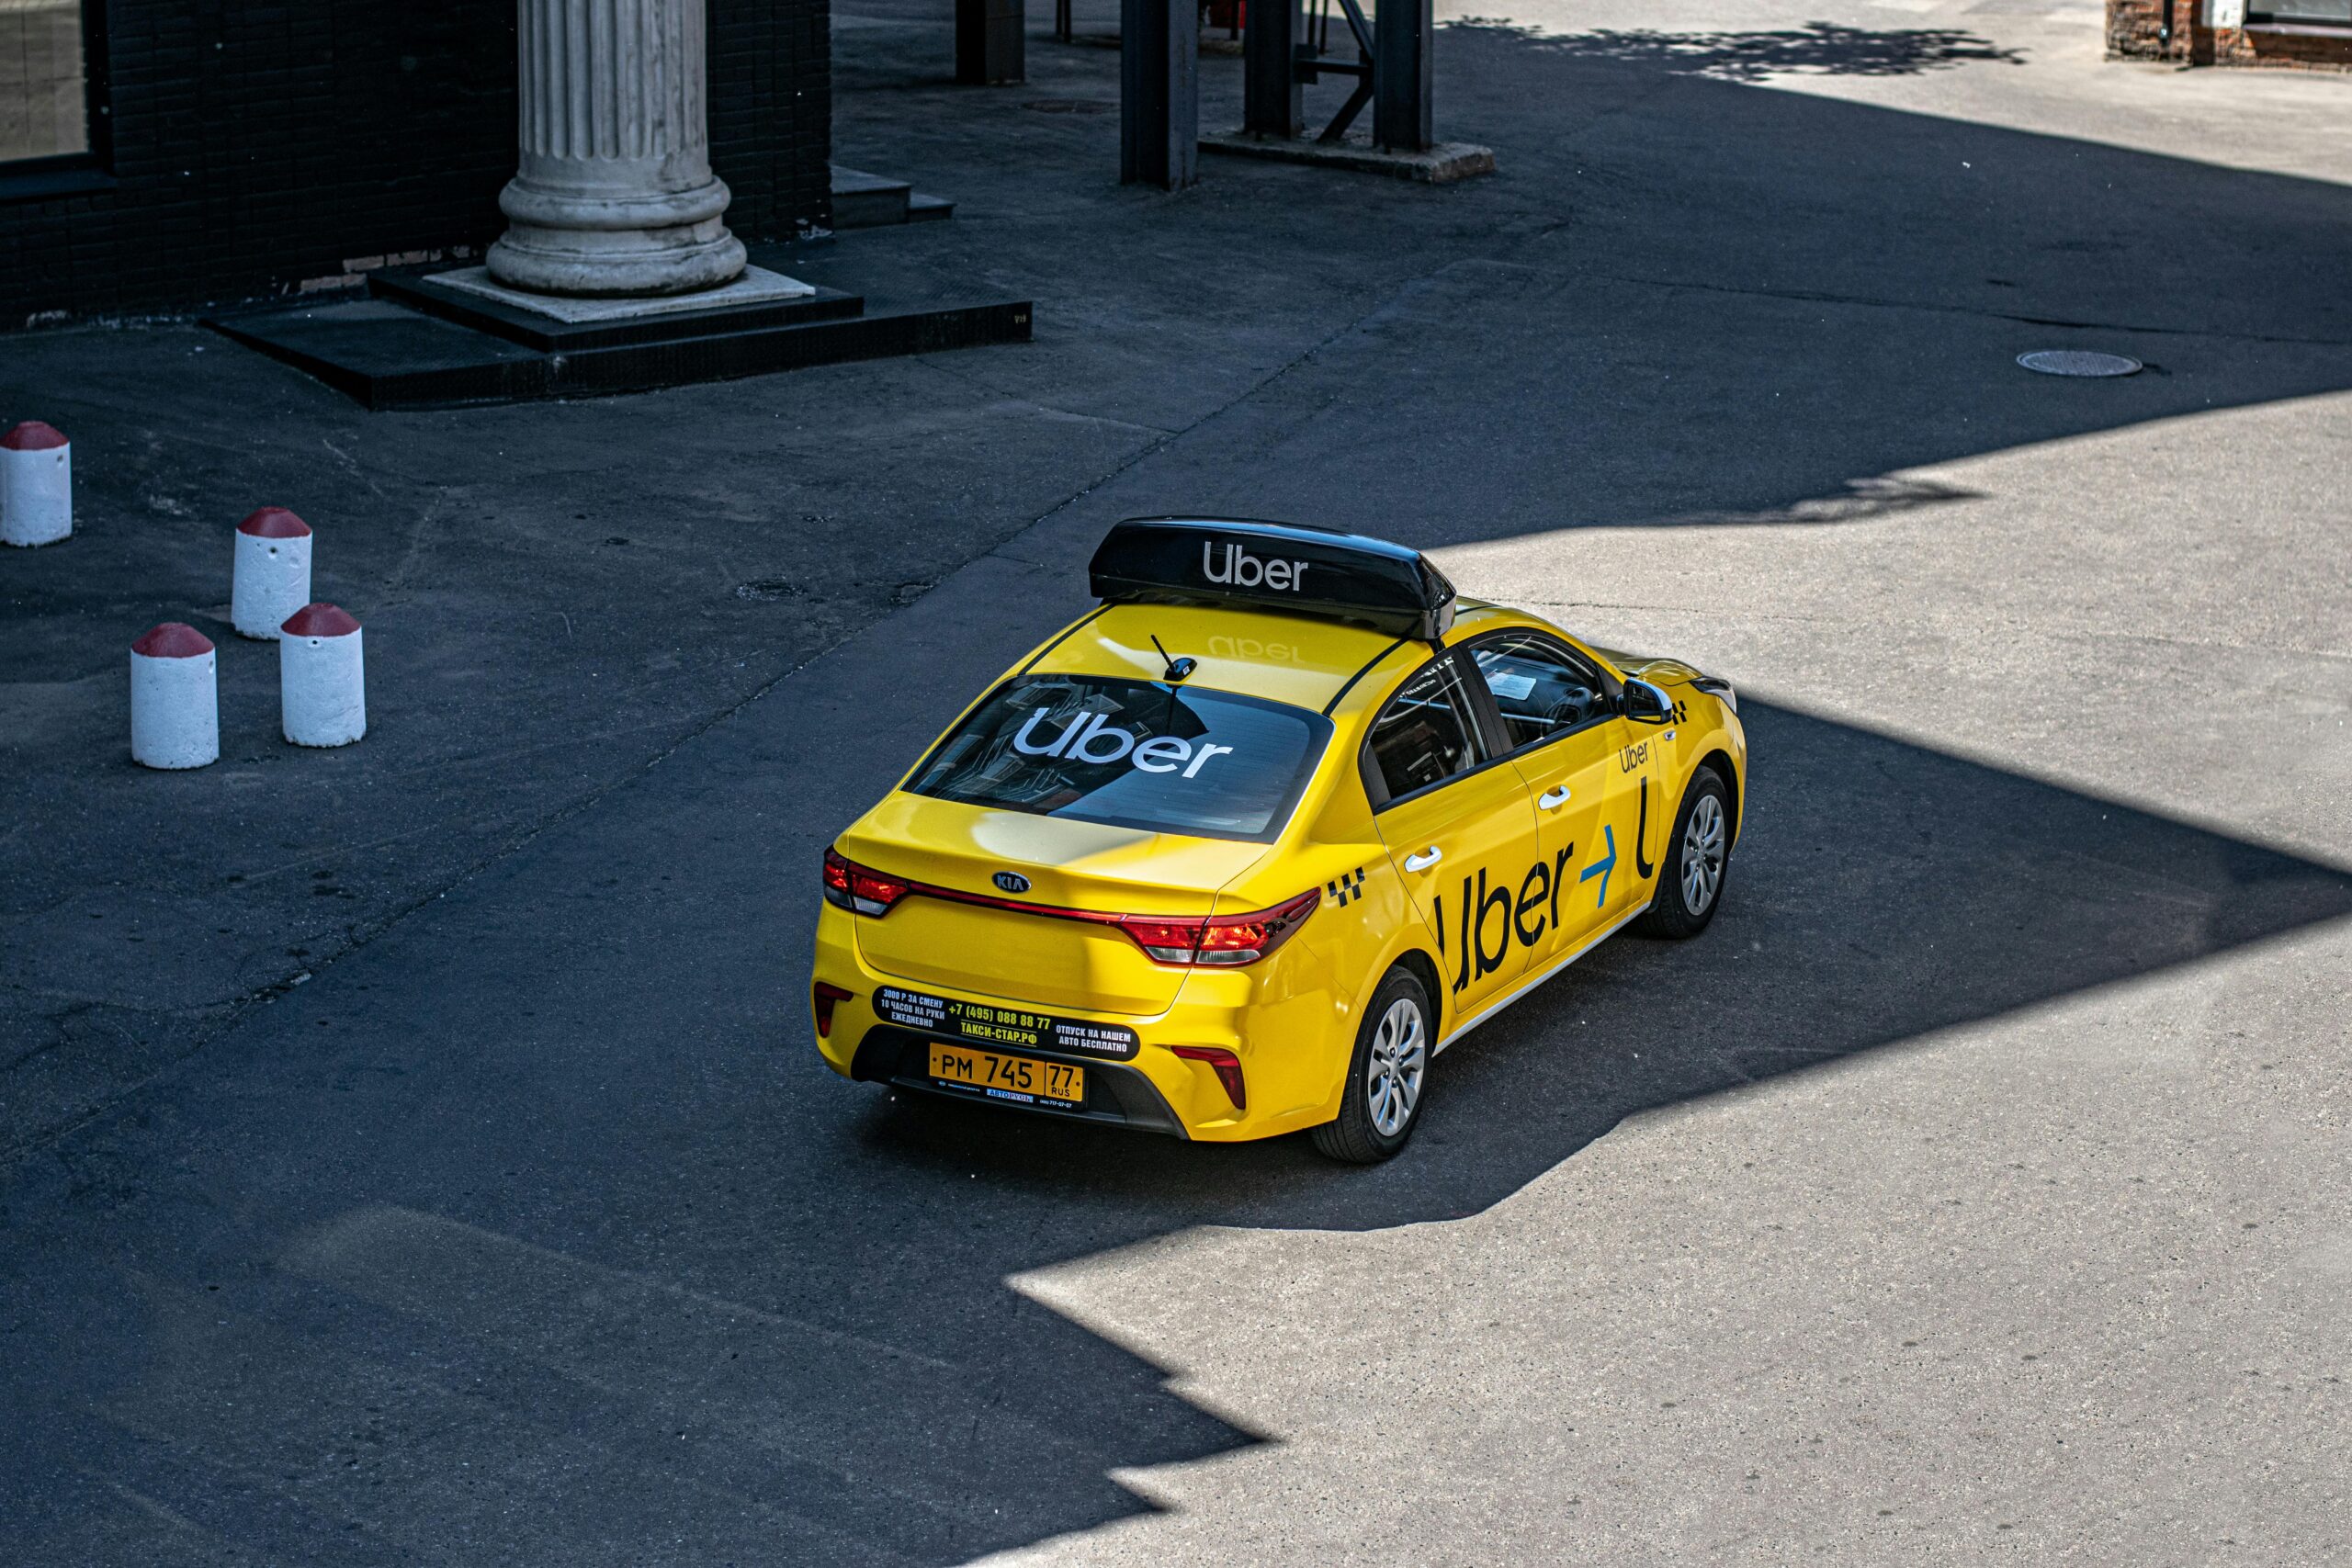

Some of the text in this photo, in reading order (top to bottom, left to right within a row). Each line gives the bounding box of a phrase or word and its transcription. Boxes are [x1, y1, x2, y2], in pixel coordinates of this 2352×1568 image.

[1203, 540, 1308, 592] Uber
[1013, 706, 1233, 779] Uber
[1619, 741, 1648, 773] Uber
[997, 874, 1024, 891] KIA
[1433, 840, 1575, 996] Uber
[881, 998, 945, 1020] 10 ЧАСОВ НА РУКИ
[883, 988, 900, 1000] 3000
[908, 994, 918, 1004] ЗА
[919, 996, 944, 1009] СМЕНУ
[891, 1011, 933, 1027] ЕЖЕДНЕВНО
[948, 1003, 1051, 1030] +7 (495) 088 88 77
[960, 1021, 1037, 1044] ТАКСИ-СТАР.РФ
[1056, 1024, 1131, 1043] ОТПУСК НА НАШЕМ
[1058, 1035, 1127, 1053] АВТО БЕСПЛАТНО
[984, 1055, 1033, 1089] 745
[1048, 1065, 1074, 1089] 77
[1051, 1087, 1070, 1097] RUS
